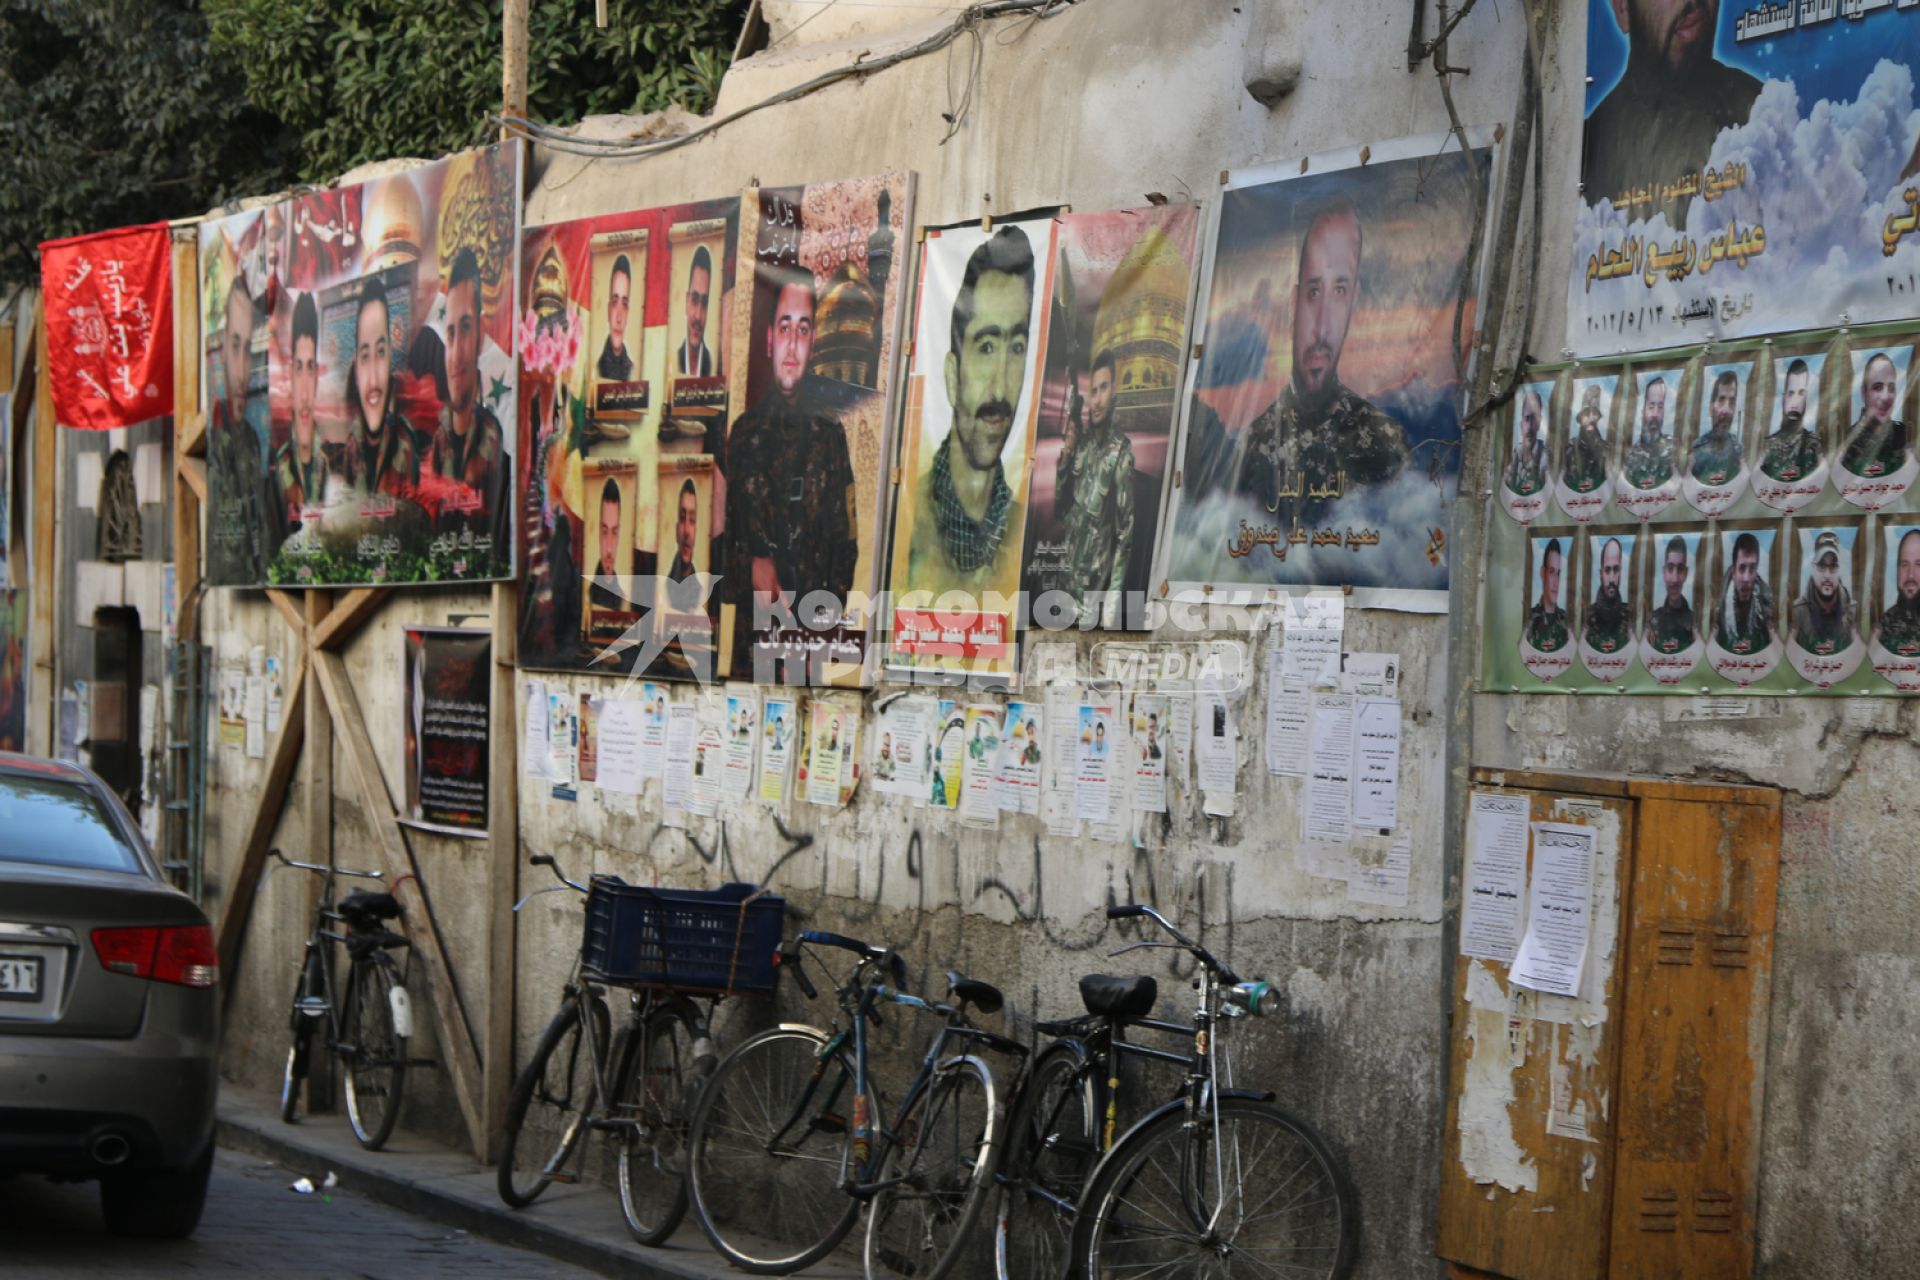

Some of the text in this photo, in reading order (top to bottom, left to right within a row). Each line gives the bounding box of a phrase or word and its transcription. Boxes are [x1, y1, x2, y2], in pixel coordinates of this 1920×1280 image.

[1644, 233, 1697, 289] ربيع
[1698, 217, 1767, 275] عباس
[1228, 515, 1380, 563] سعيد محمد علي صندوق
